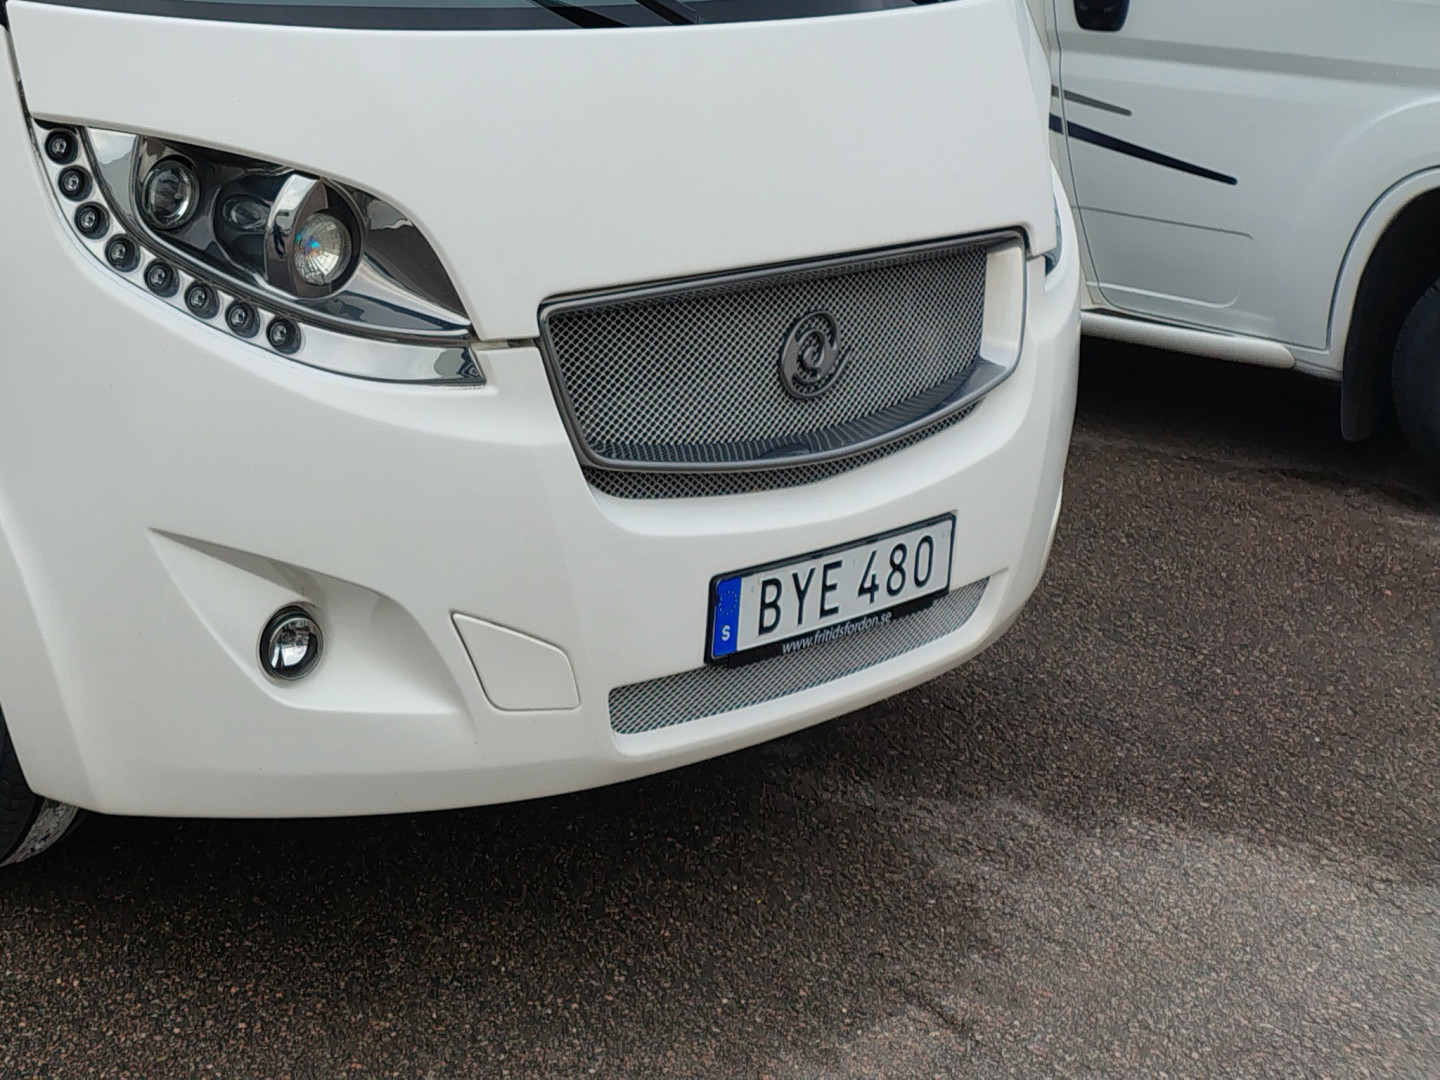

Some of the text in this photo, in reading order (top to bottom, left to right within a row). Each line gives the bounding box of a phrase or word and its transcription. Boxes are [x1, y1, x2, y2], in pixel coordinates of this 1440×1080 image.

[758, 534, 934, 636] BYE 480
[720, 624, 731, 642] S
[781, 610, 893, 655] www.fritidsfordon.se
